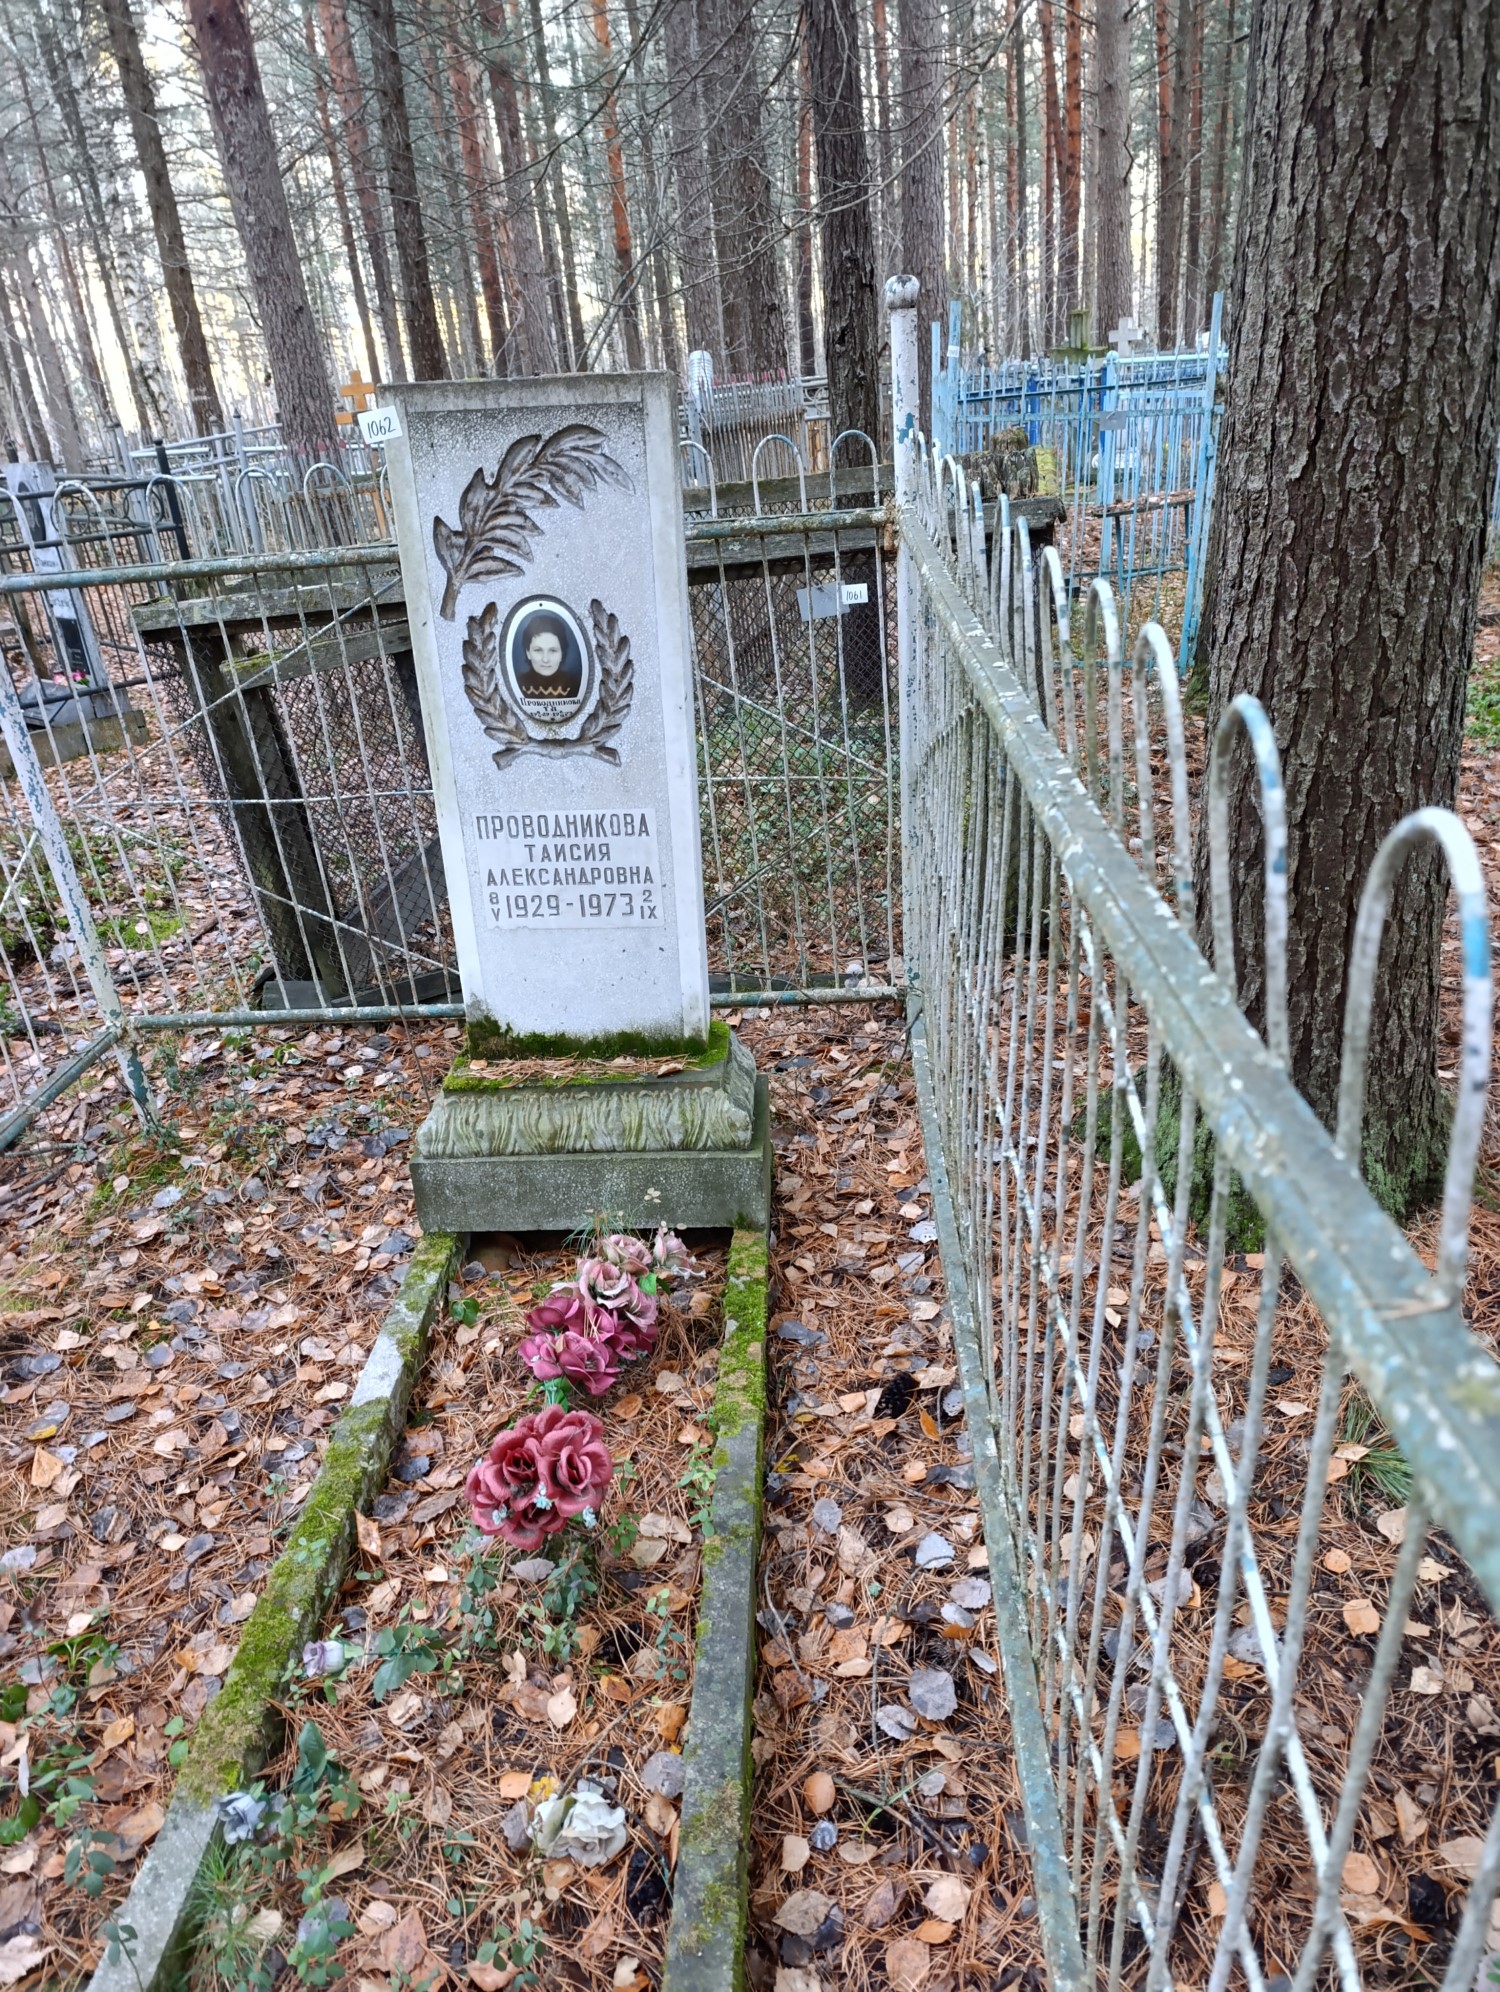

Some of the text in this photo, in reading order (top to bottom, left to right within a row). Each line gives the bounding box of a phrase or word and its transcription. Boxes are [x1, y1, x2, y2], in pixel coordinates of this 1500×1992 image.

[367, 416, 397, 439] 1062
[846, 590, 863, 602] 1061
[476, 813, 650, 840] ПРОВОДНИКОВА
[524, 843, 612, 863] ТАИСИЯ
[487, 866, 654, 887] АЛЕКСАНДРОВНА
